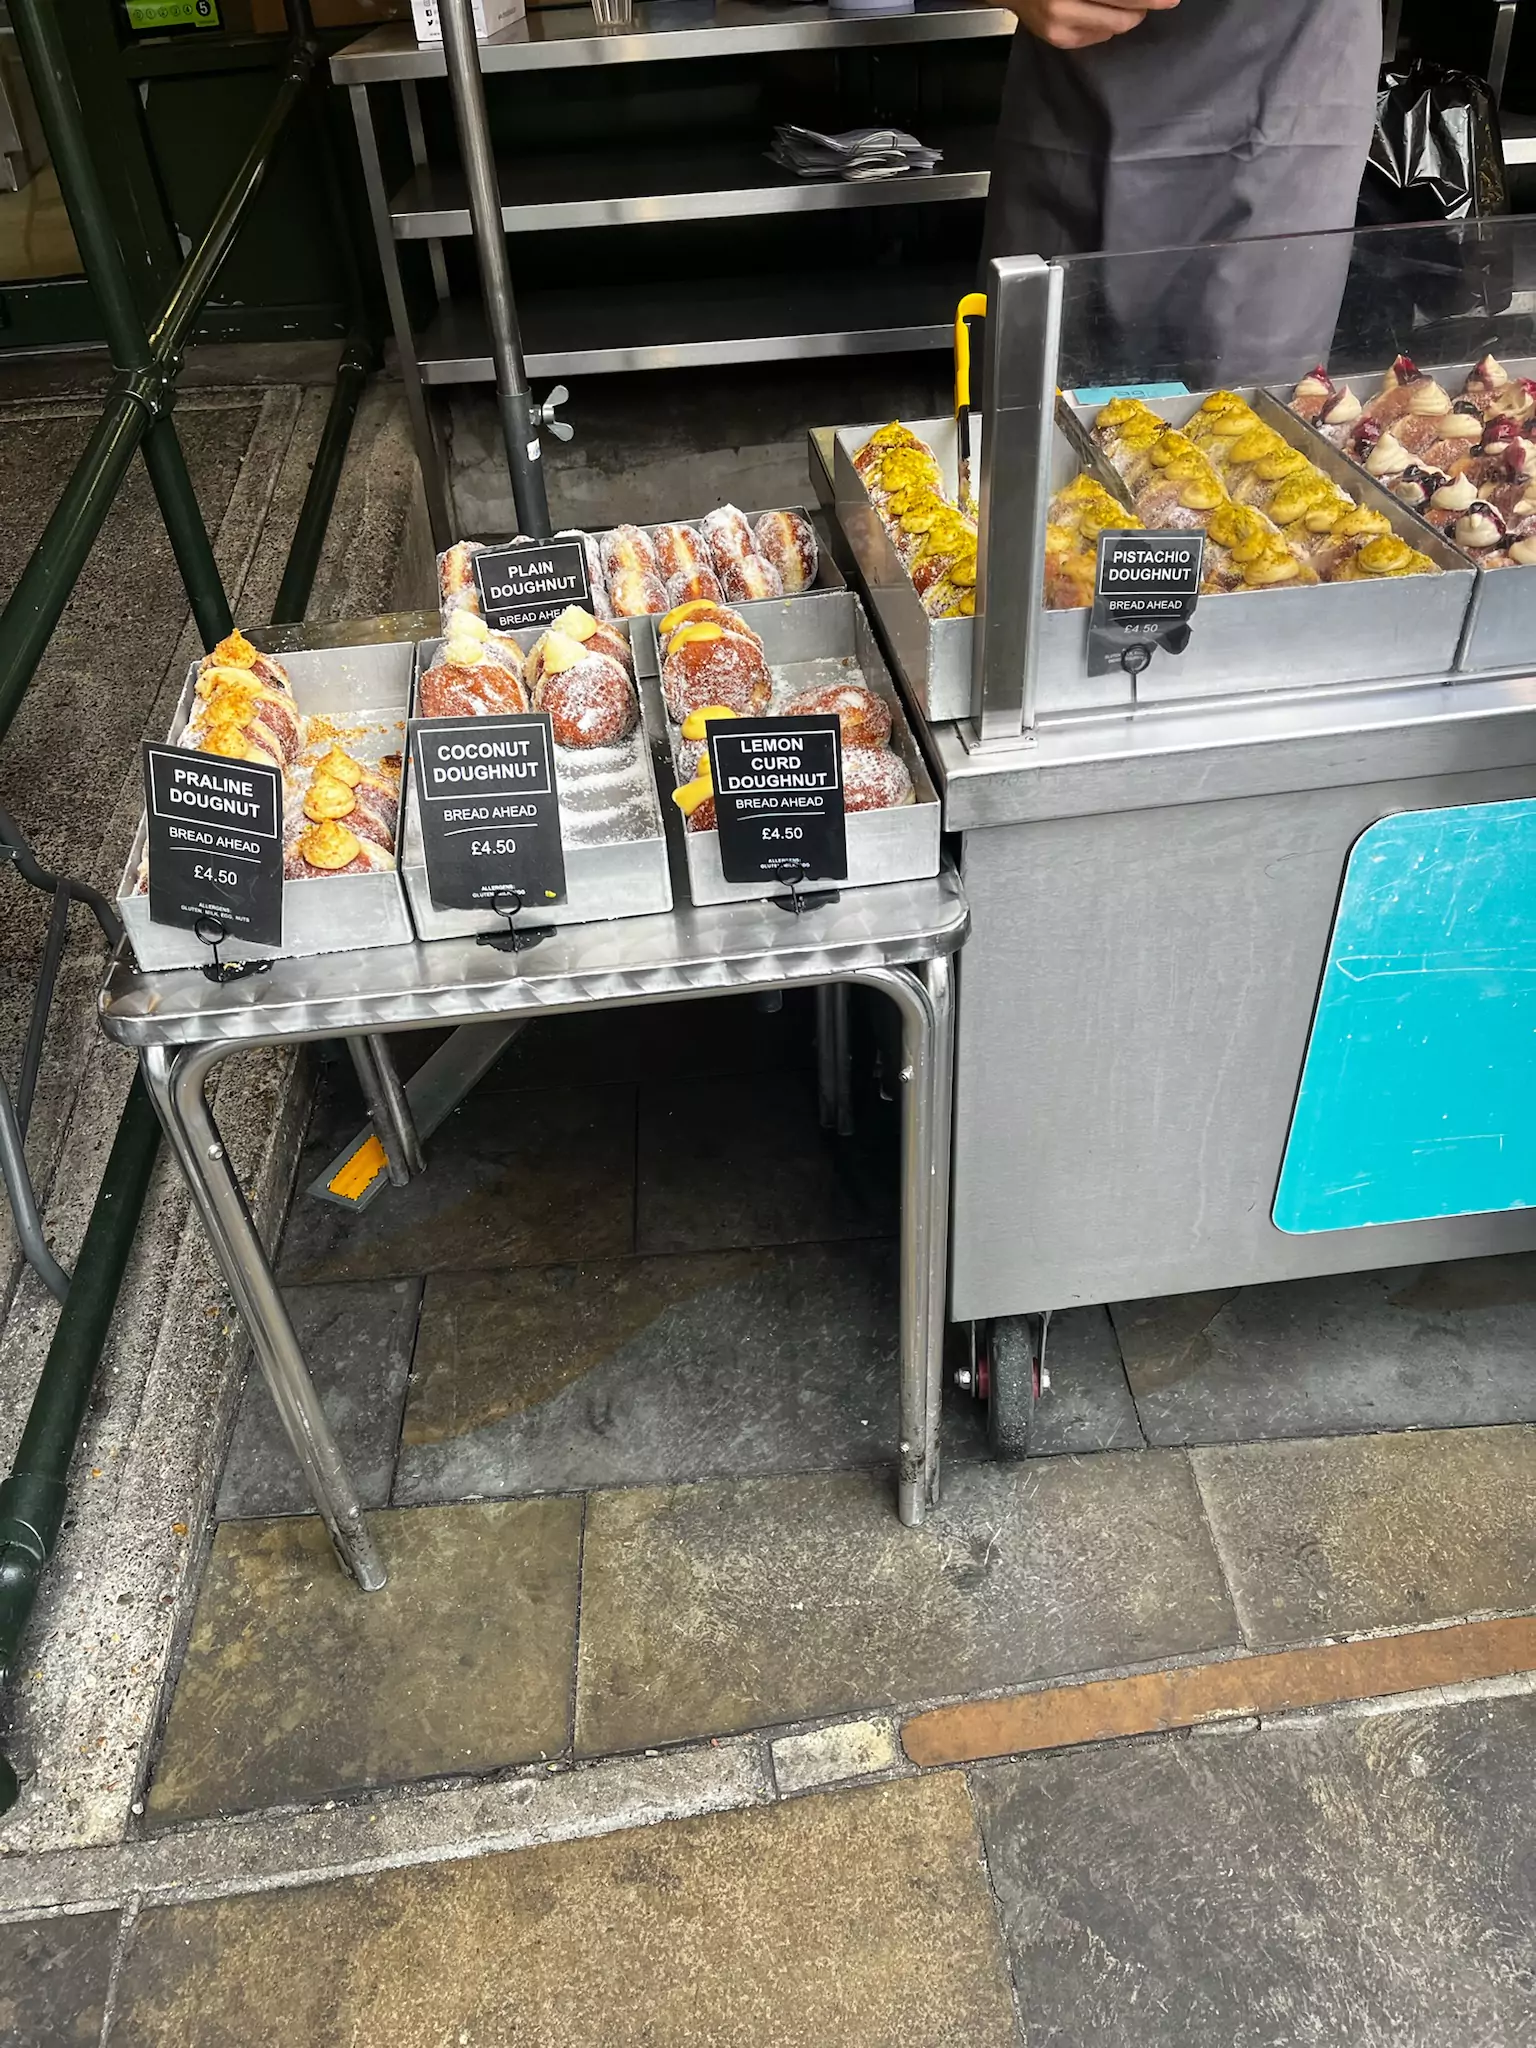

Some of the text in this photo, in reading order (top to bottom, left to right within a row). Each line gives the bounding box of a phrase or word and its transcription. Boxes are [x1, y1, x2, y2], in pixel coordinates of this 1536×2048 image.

[1113, 550, 1190, 564] PISTACHIO
[508, 561, 554, 579] PLAIN
[1108, 568, 1192, 581] DOUGHNUT
[490, 575, 577, 599] DOUGHNUT
[1109, 600, 1183, 611] BREAD AHEAD
[499, 612, 537, 627] BREAD
[1124, 623, 1159, 634] £4.50
[437, 740, 530, 761] COCONUT
[740, 737, 804, 753] LEMON
[433, 762, 539, 783] DOUGHNUT
[751, 756, 801, 771] CURD
[174, 768, 254, 798] PRALINE
[728, 772, 828, 790] DOUGHNUT
[169, 787, 261, 819] DOUGNUT
[735, 796, 824, 809] BREAD AHEAD
[443, 804, 537, 822] BREAD AHEAD
[169, 826, 261, 854] BREAD AHEAD
[762, 827, 803, 840] £4.50
[471, 838, 516, 856] £4.50
[194, 864, 238, 886] £4.50
